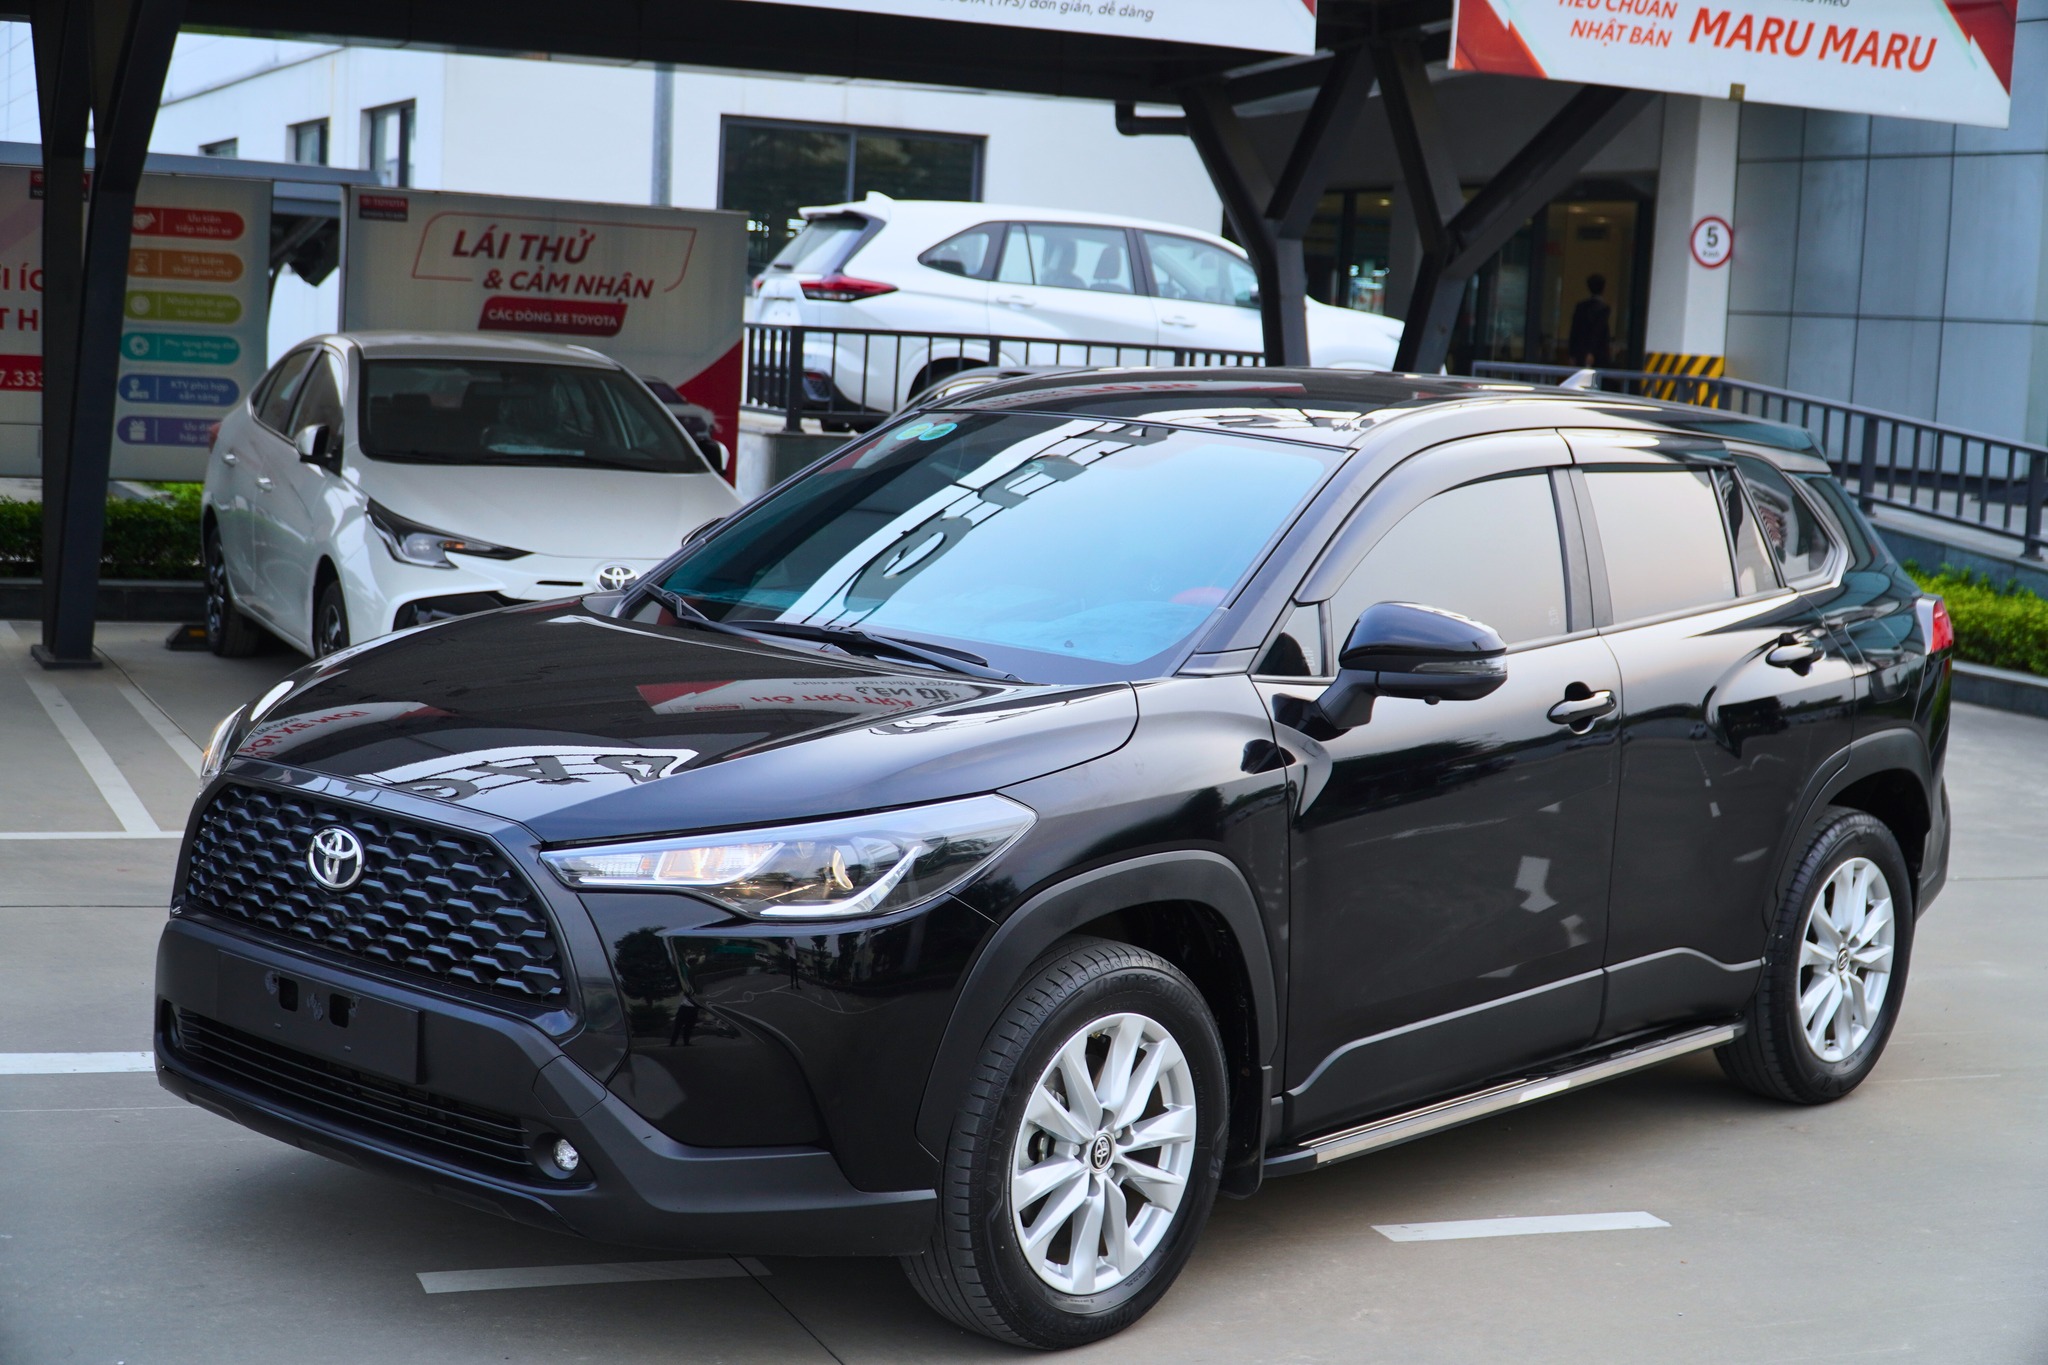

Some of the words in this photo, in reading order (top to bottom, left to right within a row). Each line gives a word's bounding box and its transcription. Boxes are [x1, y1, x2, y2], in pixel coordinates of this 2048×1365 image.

[1119, 4, 1154, 22] dàng
[1570, 18, 1628, 47] NHẬT
[1629, 22, 1673, 48] BẢN
[1688, 7, 1815, 58] MARU
[1818, 24, 1938, 73] MARU
[452, 224, 511, 259] LÁI
[519, 228, 595, 264] THỬ
[1707, 226, 1718, 248] 5
[19, 262, 43, 292] ÍC
[483, 268, 503, 290] &
[509, 265, 570, 294] CẢM
[574, 271, 655, 304] NHẬN
[488, 307, 514, 321] CÁC
[554, 313, 569, 325] XE
[571, 313, 618, 327] TOYOTA
